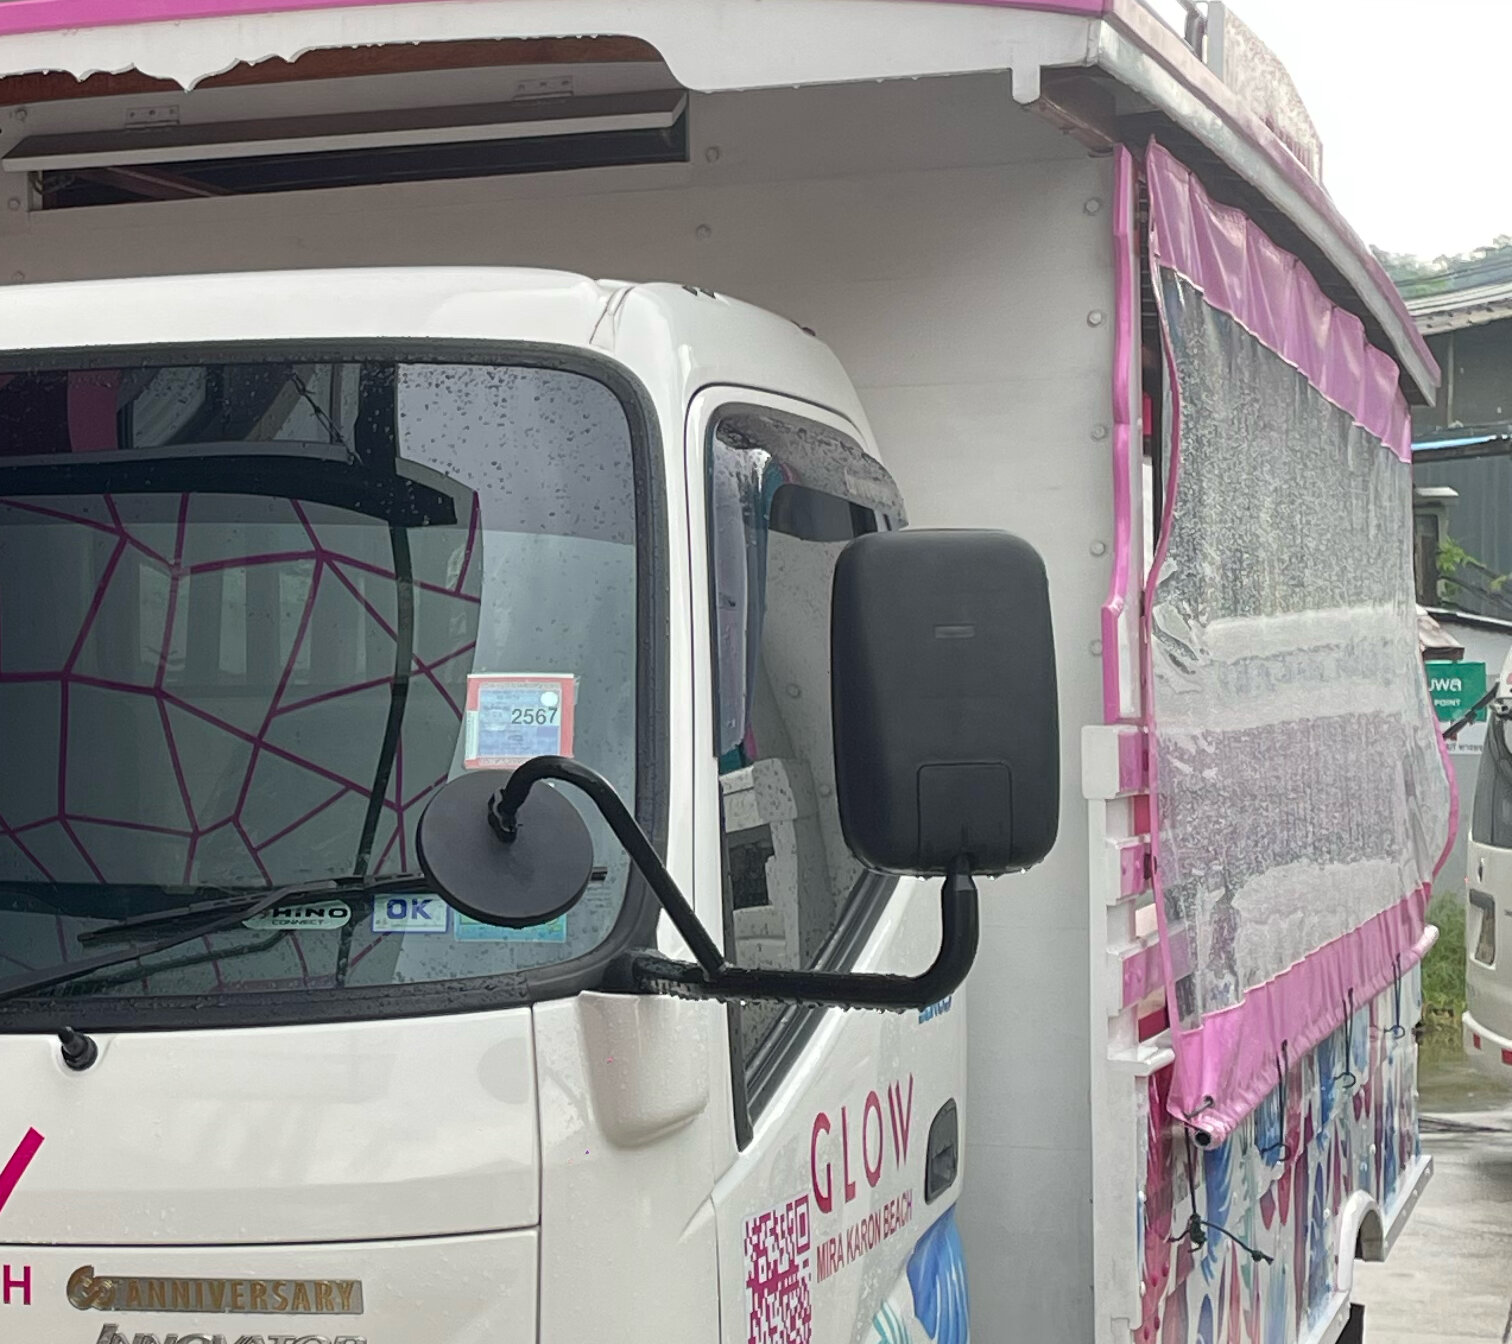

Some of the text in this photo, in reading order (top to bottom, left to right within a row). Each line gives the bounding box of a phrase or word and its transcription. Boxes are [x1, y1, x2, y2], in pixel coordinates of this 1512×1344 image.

[511, 707, 559, 725] 2567
[385, 898, 433, 921] OK
[811, 1072, 914, 1214] GLOW
[816, 1189, 913, 1284] MIRA KARON BEACH
[124, 1278, 356, 1313] ANNIVERSARY
